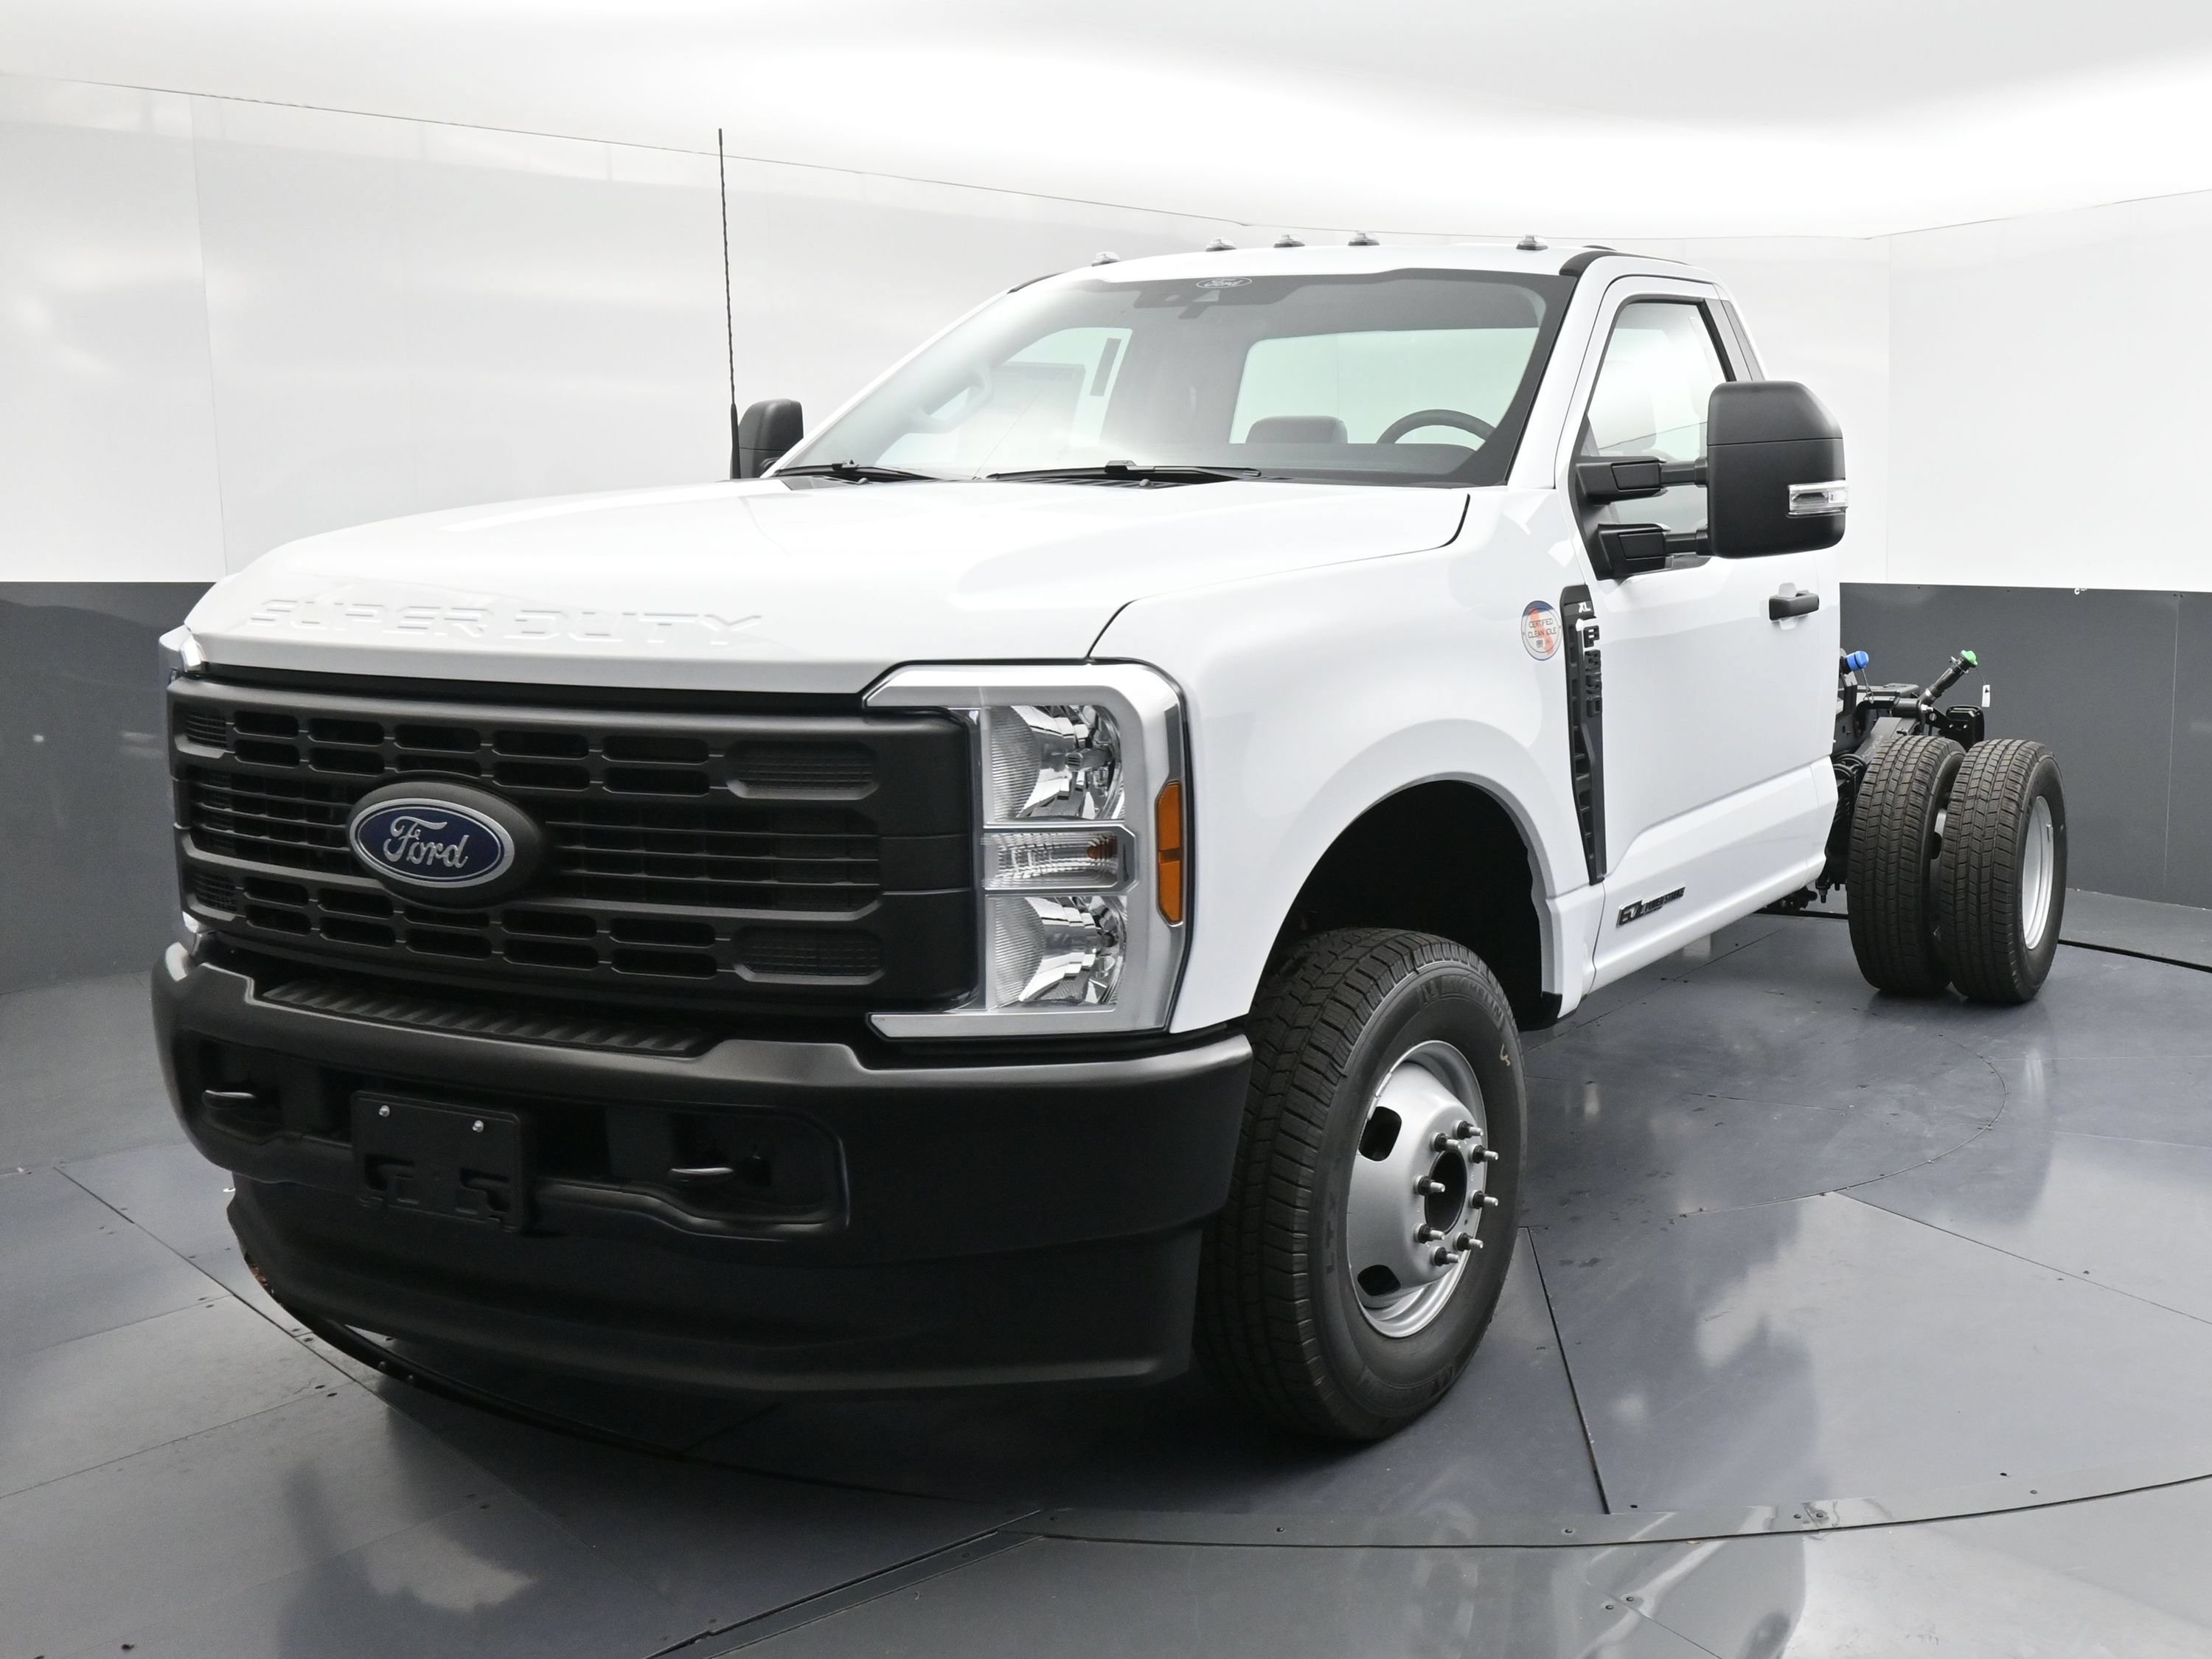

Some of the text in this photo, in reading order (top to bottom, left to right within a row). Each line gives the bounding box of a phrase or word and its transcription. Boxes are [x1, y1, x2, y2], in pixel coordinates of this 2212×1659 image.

[1578, 601, 1592, 613] XL
[248, 599, 764, 646] SUPER DUTY
[1528, 618, 1554, 628] CERTIFIED
[1527, 627, 1557, 639] CLEAN IDLE
[383, 815, 470, 869] Ford
